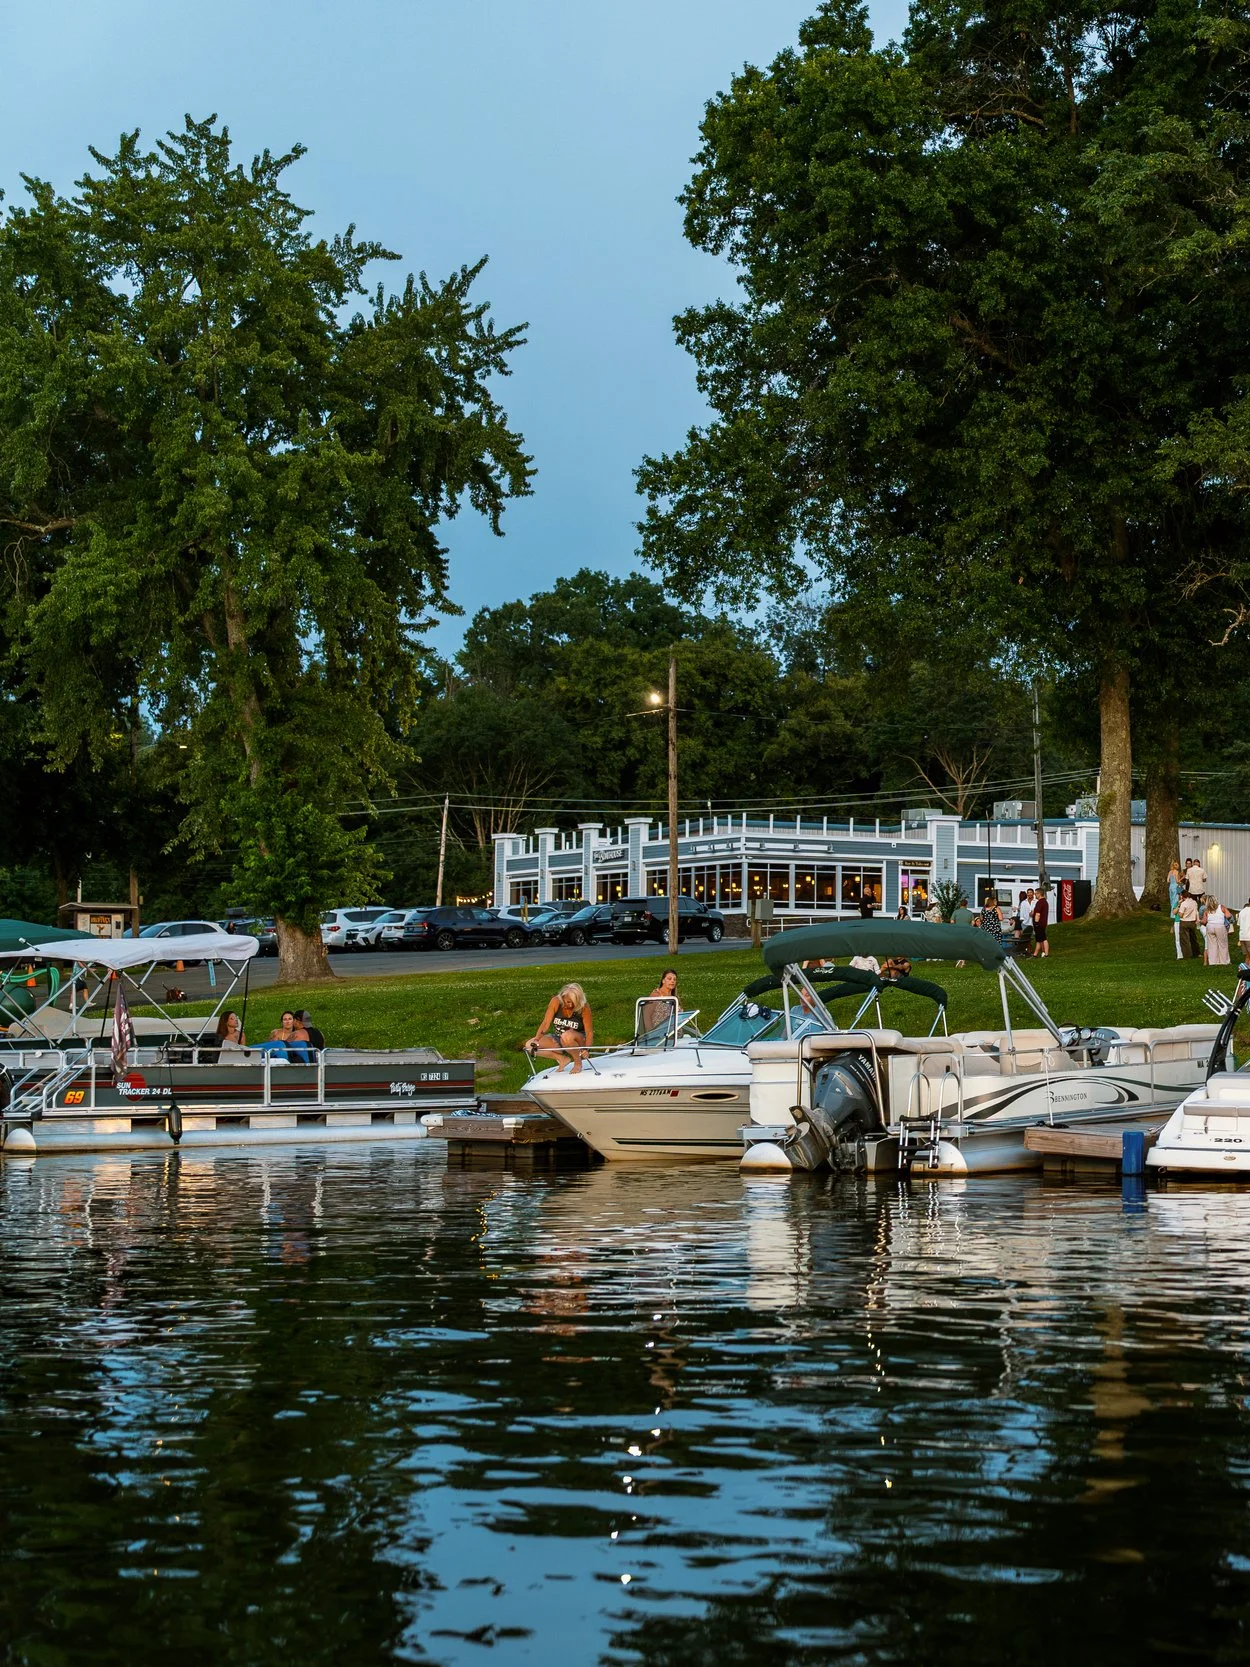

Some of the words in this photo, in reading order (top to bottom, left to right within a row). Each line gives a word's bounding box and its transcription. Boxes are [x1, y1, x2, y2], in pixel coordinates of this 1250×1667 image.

[1063, 883, 1072, 916] Coca-Cola
[553, 1017, 579, 1030] BLAME
[63, 1089, 85, 1105] 69
[118, 1088, 150, 1096] TRACKER
[1054, 1093, 1088, 1103] BENNINGTON
